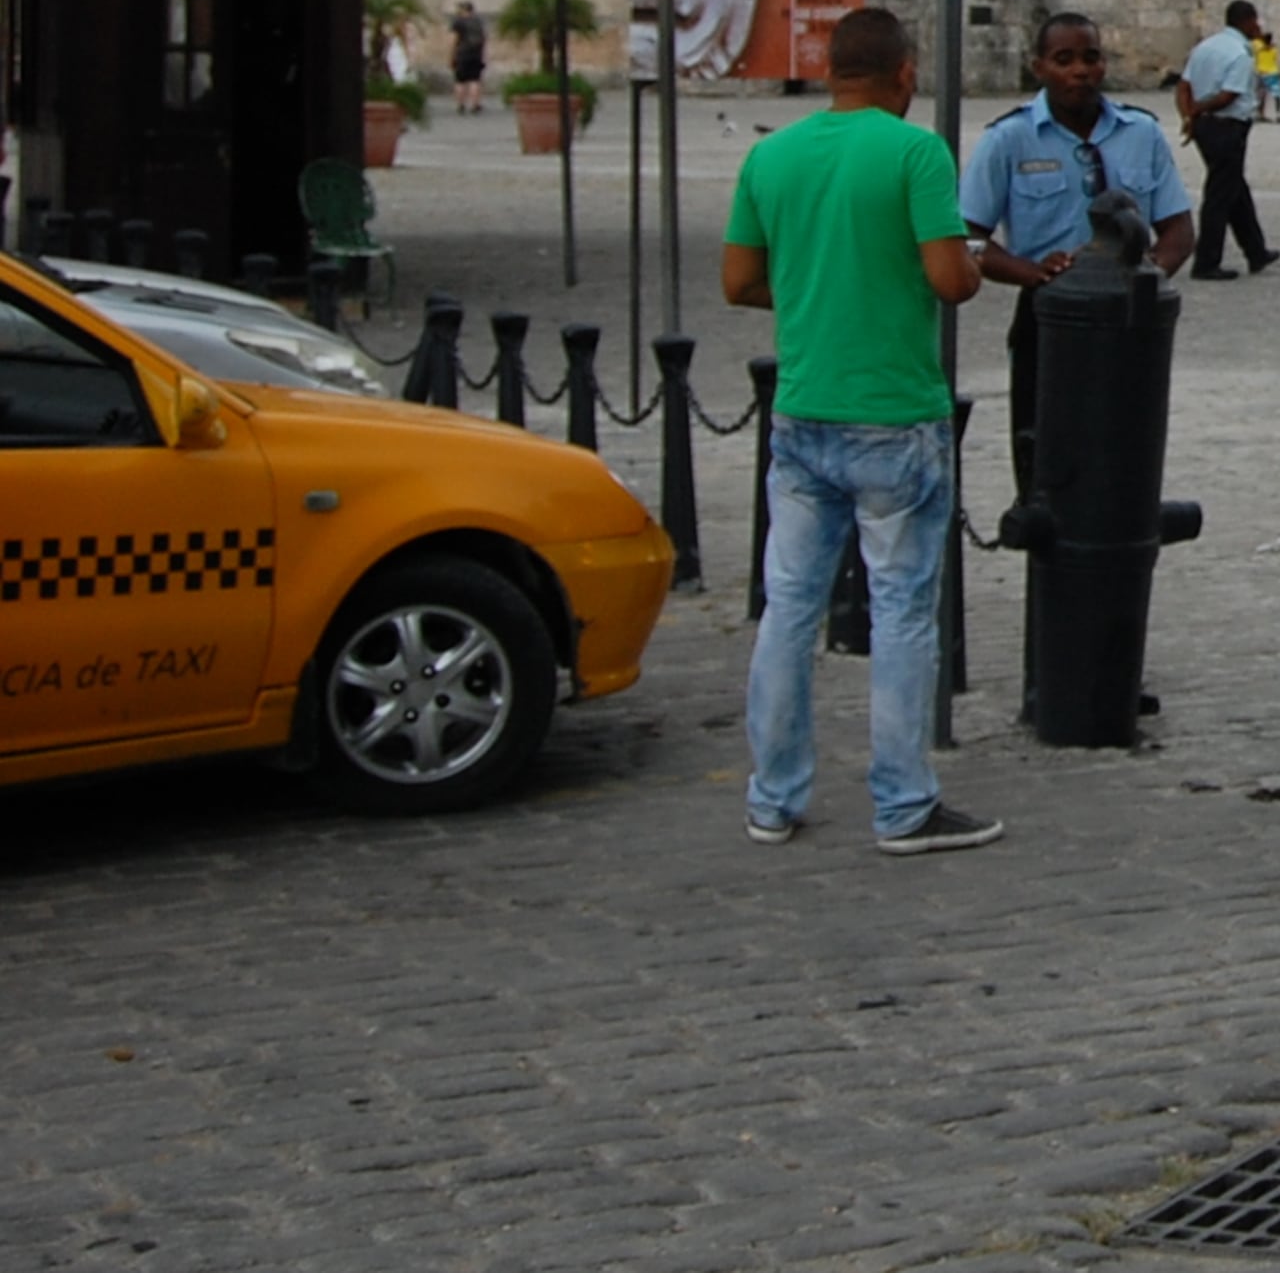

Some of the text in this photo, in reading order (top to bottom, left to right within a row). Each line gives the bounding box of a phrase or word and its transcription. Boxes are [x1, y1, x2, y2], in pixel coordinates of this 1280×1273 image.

[0, 643, 220, 697] CIA de TAXI
